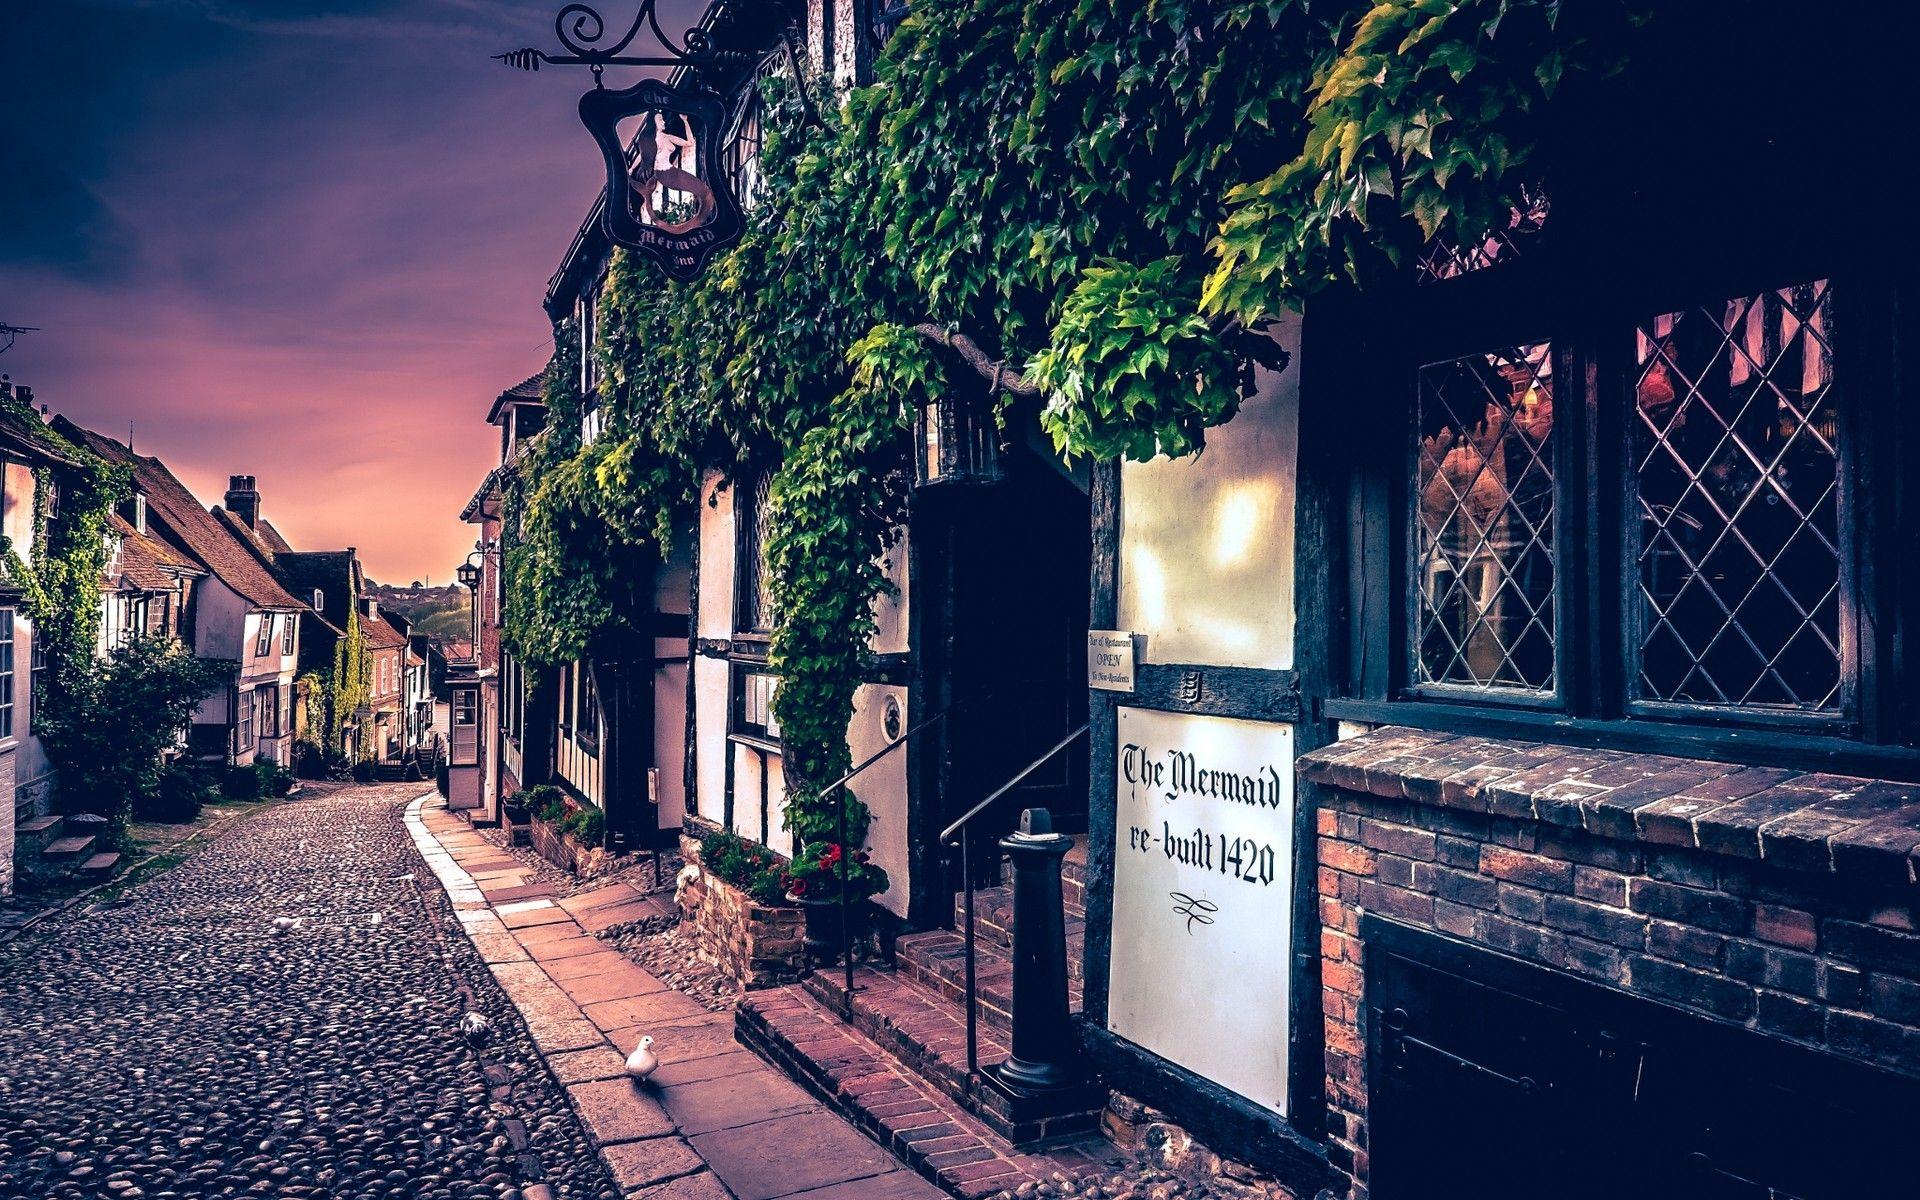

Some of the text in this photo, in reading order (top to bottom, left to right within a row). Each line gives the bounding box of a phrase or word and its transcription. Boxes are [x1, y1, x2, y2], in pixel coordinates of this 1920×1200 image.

[643, 90, 670, 105] The
[638, 228, 715, 250] Mermaid
[1096, 653, 1122, 667] OPEN
[1121, 743, 1280, 810] The Mermaid
[1130, 820, 1275, 887] re-built 1420
